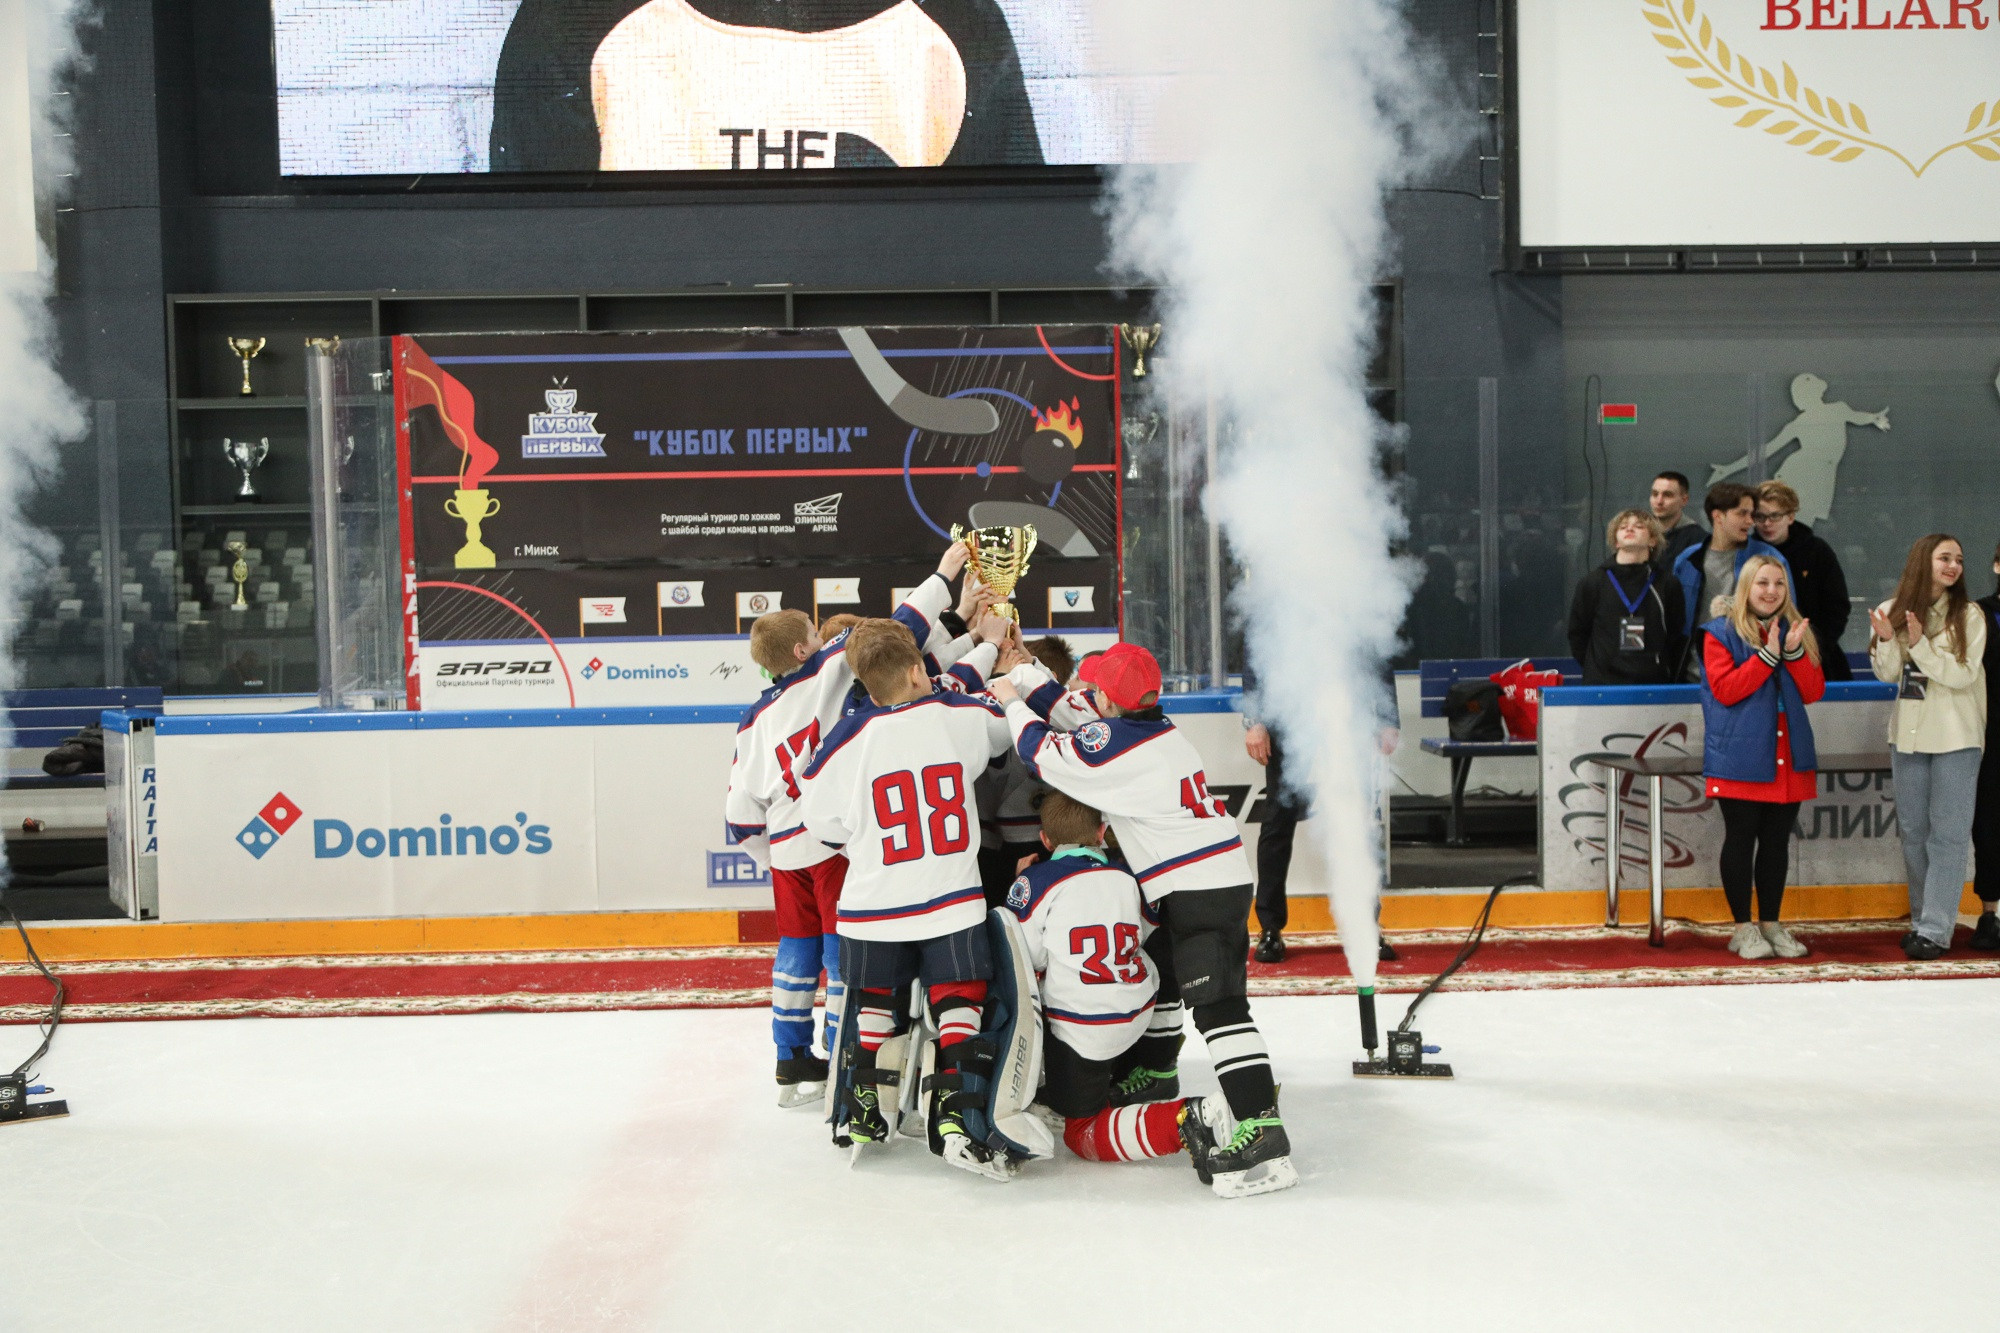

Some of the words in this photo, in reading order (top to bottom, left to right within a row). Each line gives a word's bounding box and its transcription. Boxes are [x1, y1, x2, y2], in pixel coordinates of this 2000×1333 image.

[1760, 0, 2000, 31] BELAR
[534, 416, 591, 434] КУБОК
[526, 438, 600, 454] ПЕРВЫХ
[661, 513, 709, 524] Регулярный
[710, 514, 738, 524] турнир
[740, 513, 750, 521] по
[751, 513, 781, 522] хоккею
[661, 527, 667, 535] с
[668, 525, 700, 535] шайбой
[701, 526, 726, 536] среди
[727, 525, 757, 535] команд
[758, 525, 769, 534] на
[769, 525, 796, 535] призы
[812, 524, 838, 533] АРЕНА
[514, 546, 522, 556] г.
[524, 544, 560, 556] Минск
[436, 660, 553, 677] ЗАРЯД
[436, 678, 490, 688] Официальный
[524, 677, 556, 686] турнира
[1523, 688, 1539, 702] SPL
[142, 768, 158, 853] RAITA
[872, 762, 970, 866] 98
[1069, 923, 1149, 984] 39
